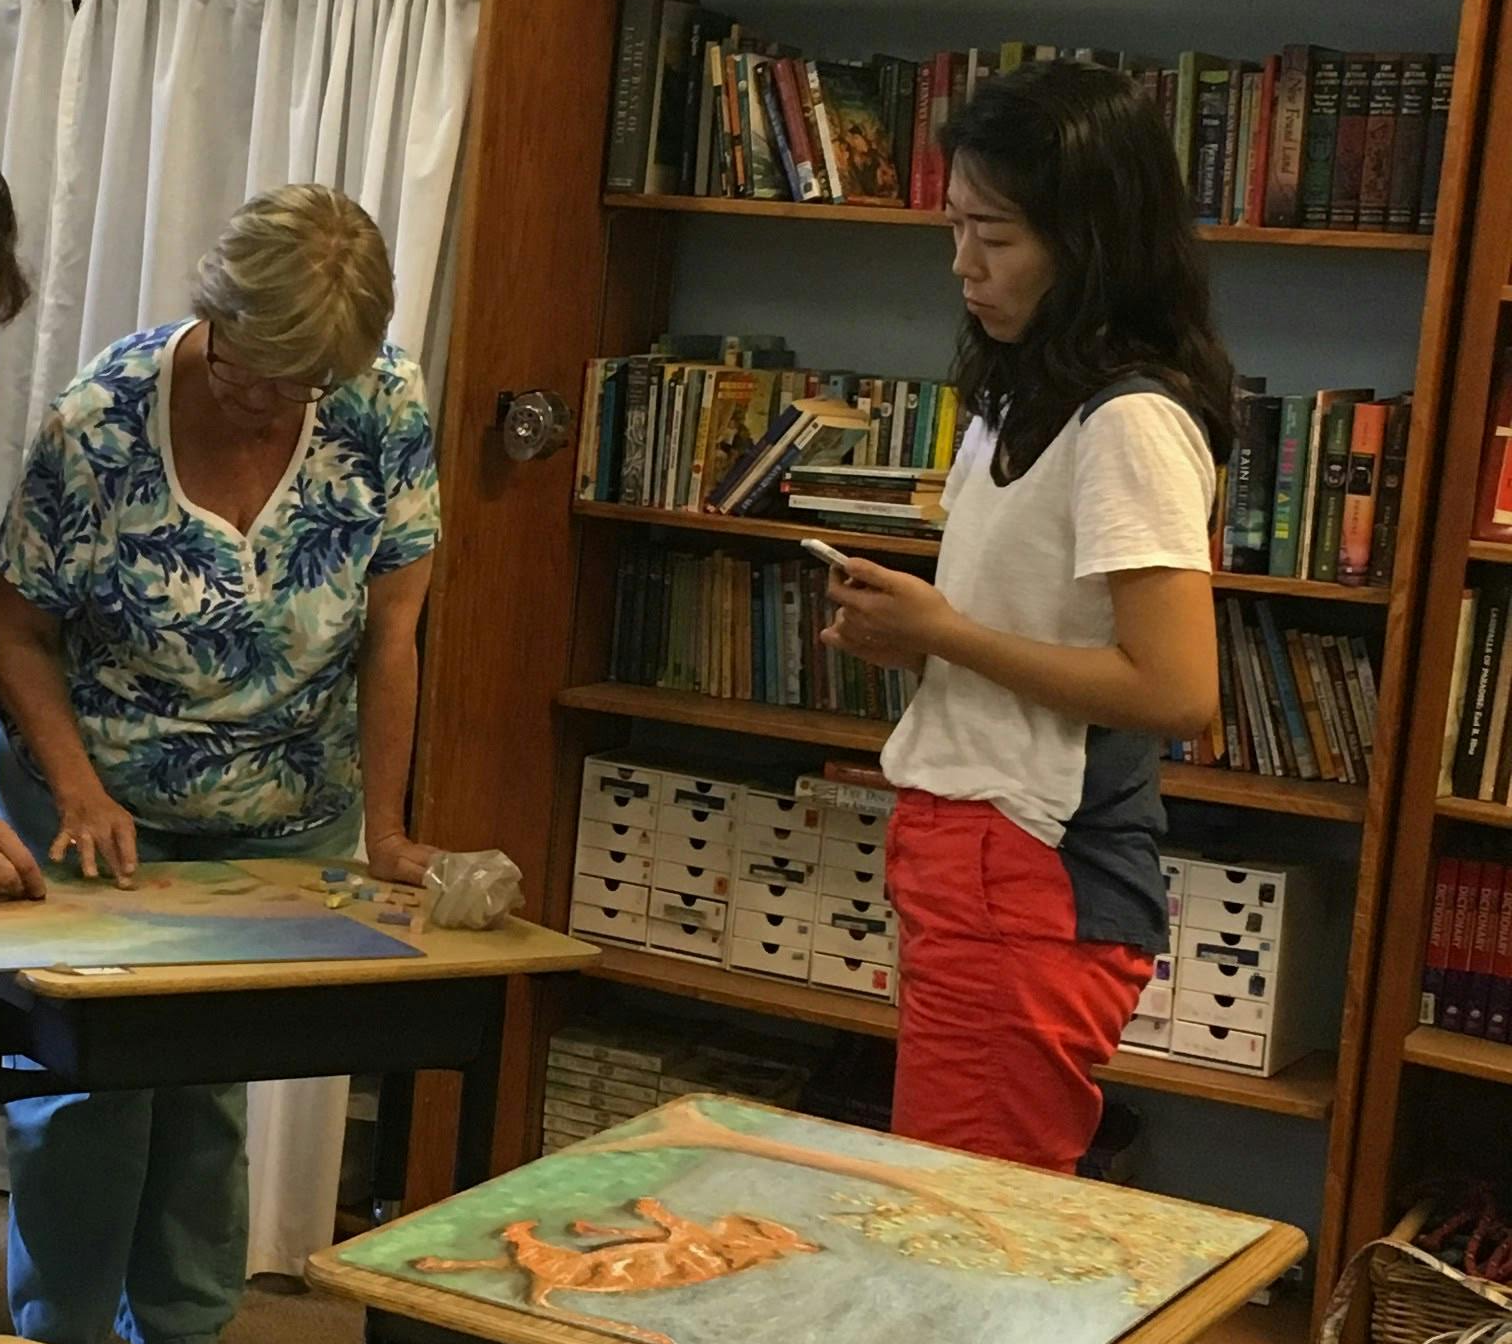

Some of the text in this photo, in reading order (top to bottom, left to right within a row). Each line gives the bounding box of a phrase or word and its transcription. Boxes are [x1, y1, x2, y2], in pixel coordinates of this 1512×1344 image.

[1281, 146, 1296, 174] Land
[1239, 448, 1252, 480] RAIN
[1431, 884, 1447, 946] DICTIONARY
[1452, 886, 1468, 949] DICTIONARY
[1475, 888, 1491, 951] DICTIONARY
